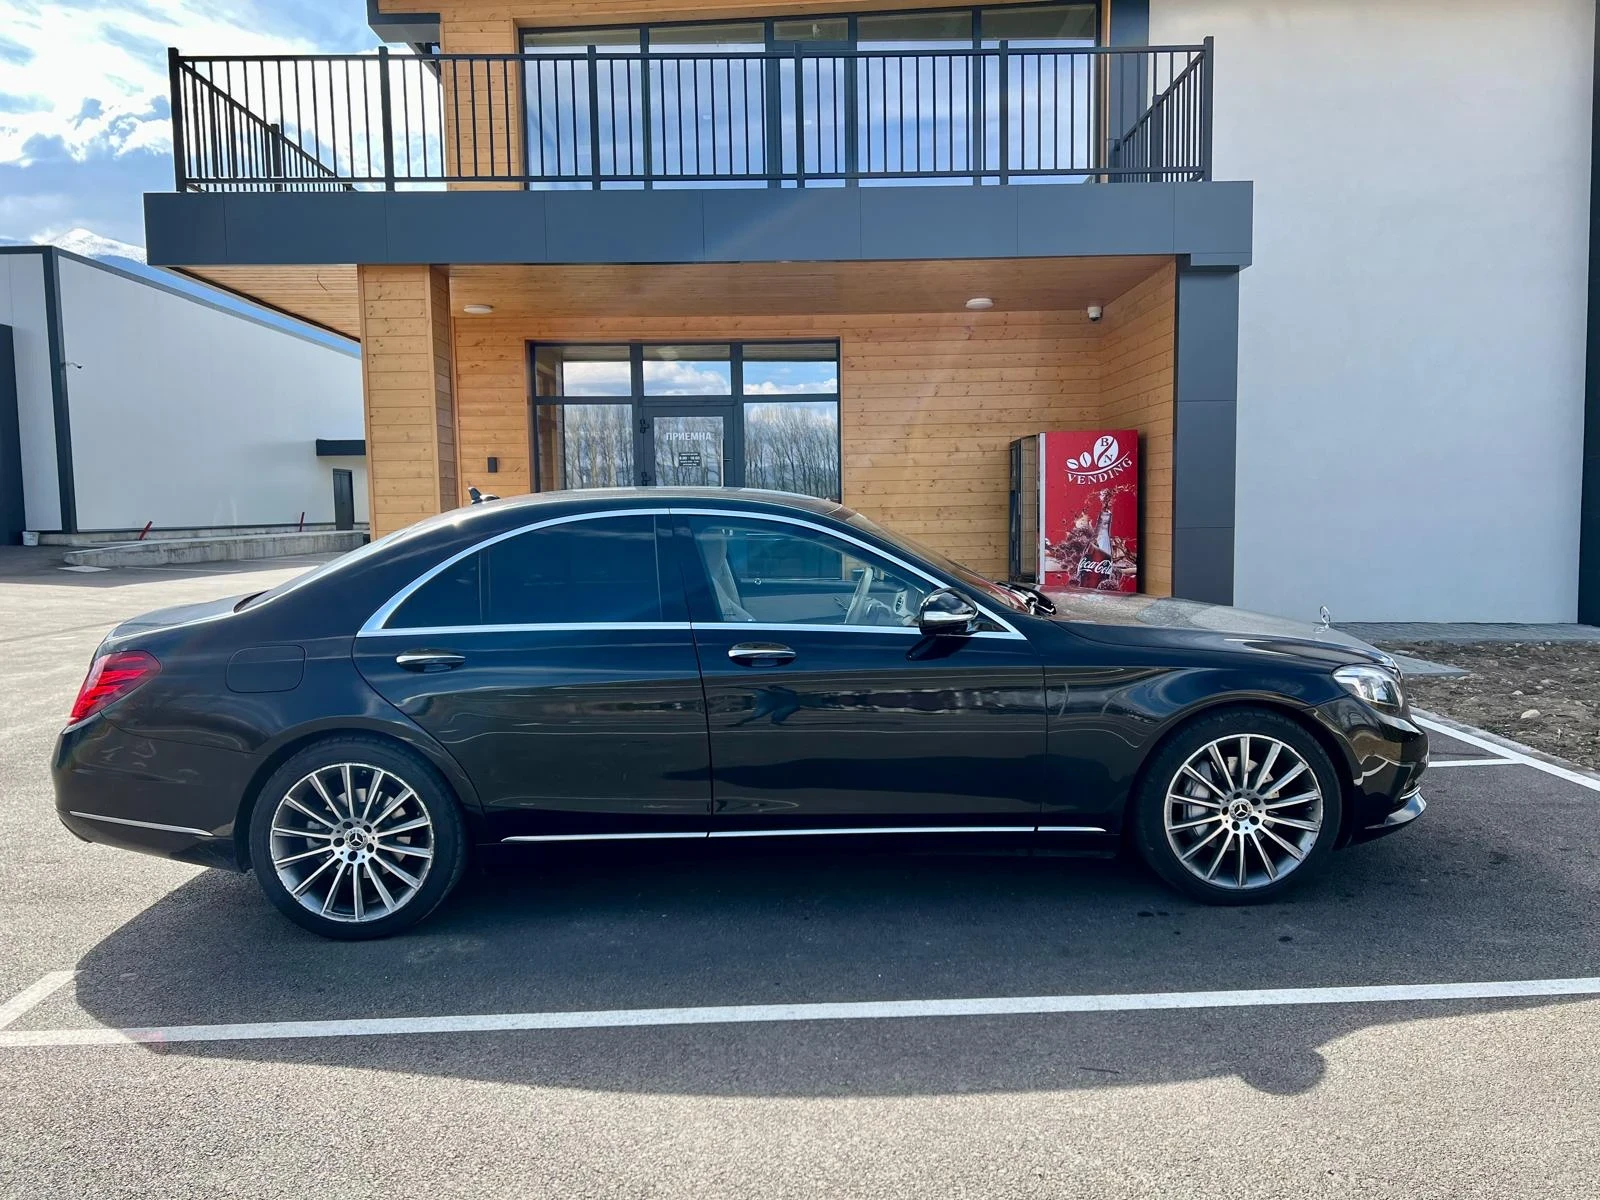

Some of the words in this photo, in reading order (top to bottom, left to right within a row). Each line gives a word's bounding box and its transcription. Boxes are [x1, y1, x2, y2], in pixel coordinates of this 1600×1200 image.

[666, 432, 712, 441] ПРИЕМНА
[1100, 437, 1109, 447] B
[1104, 454, 1113, 463] N
[1067, 457, 1133, 485] VENDING
